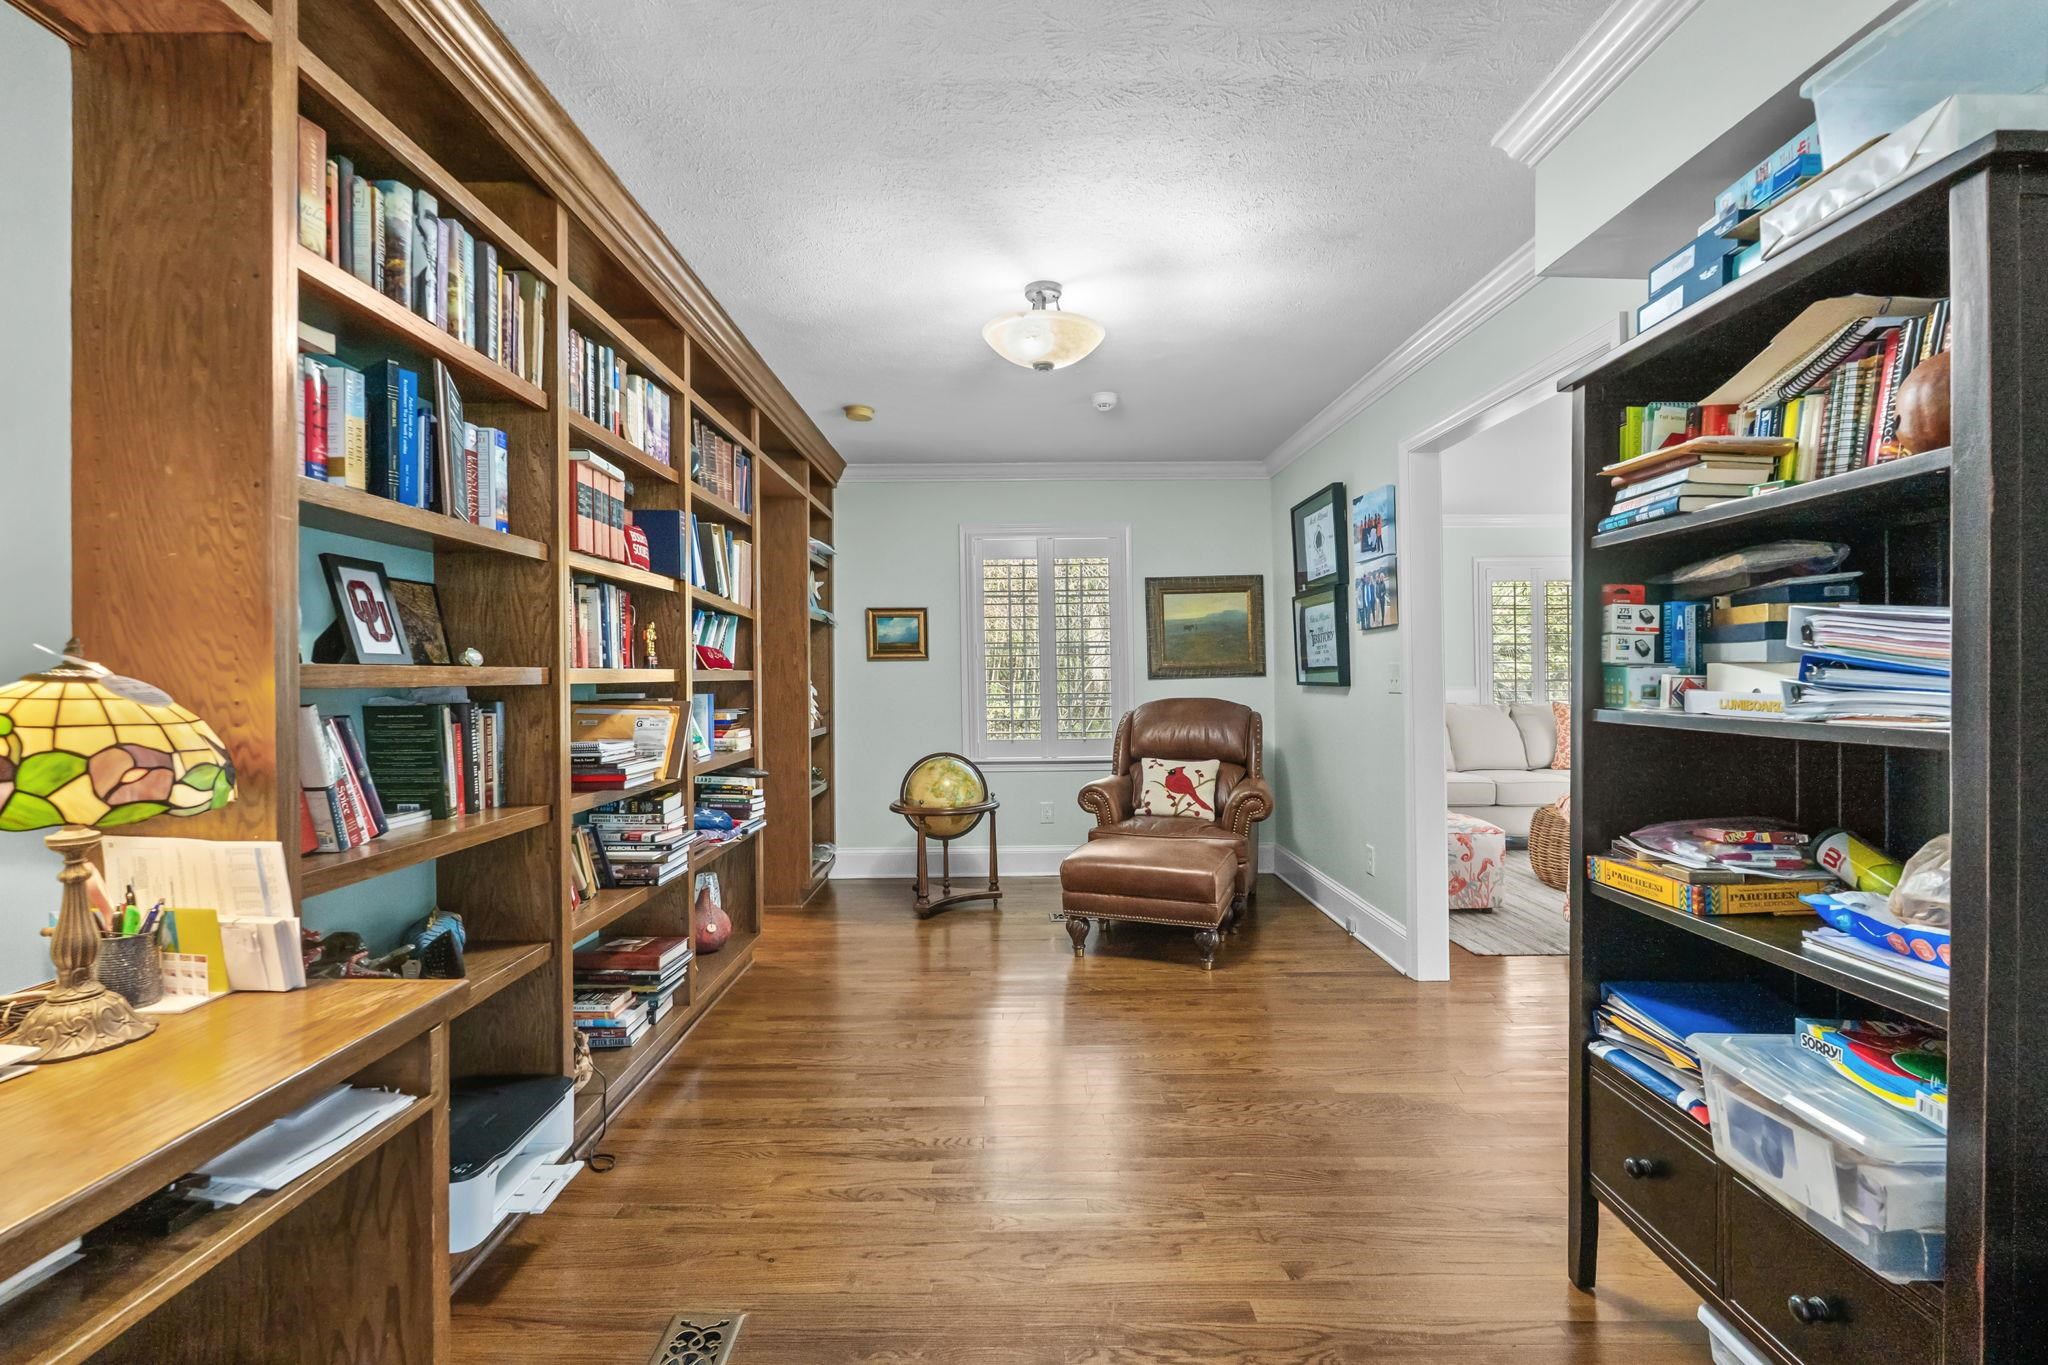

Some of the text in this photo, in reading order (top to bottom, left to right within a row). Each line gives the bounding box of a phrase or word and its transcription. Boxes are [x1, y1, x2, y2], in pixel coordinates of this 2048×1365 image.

[1892, 344, 1904, 384] DAVID
[347, 579, 394, 643] OU
[1664, 605, 1672, 644] AMERICAN
[636, 720, 643, 728] G
[337, 785, 350, 816] Spice
[1725, 831, 1748, 843] UNO
[1611, 870, 1664, 893] PARCHEESI
[610, 1038, 625, 1046] STARK
[1801, 1033, 1843, 1063] SORRY!
